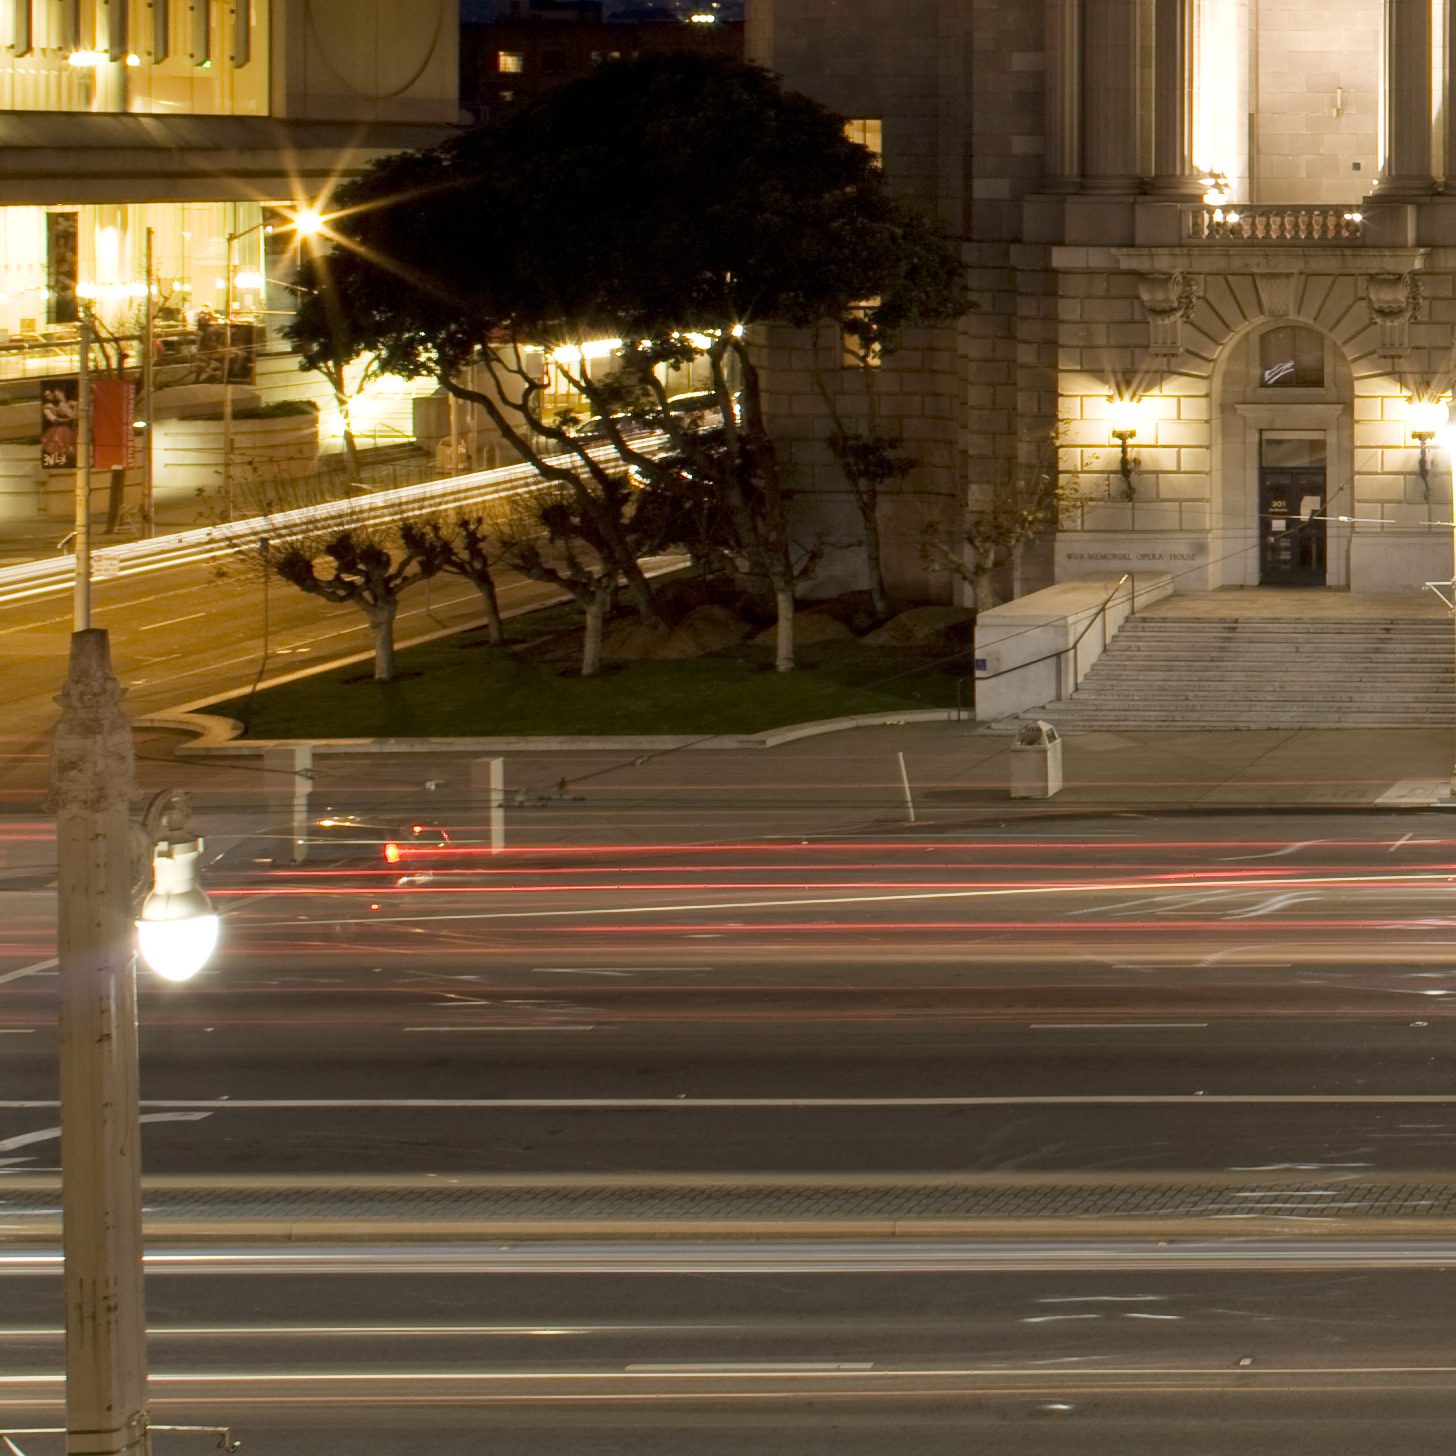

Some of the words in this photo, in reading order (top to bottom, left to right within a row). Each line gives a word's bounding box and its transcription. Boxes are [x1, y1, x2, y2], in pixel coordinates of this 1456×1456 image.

[1088, 553, 1132, 561] MEMORIAL
[1136, 553, 1164, 561] OPERA
[1169, 553, 1196, 561] HOUSE
